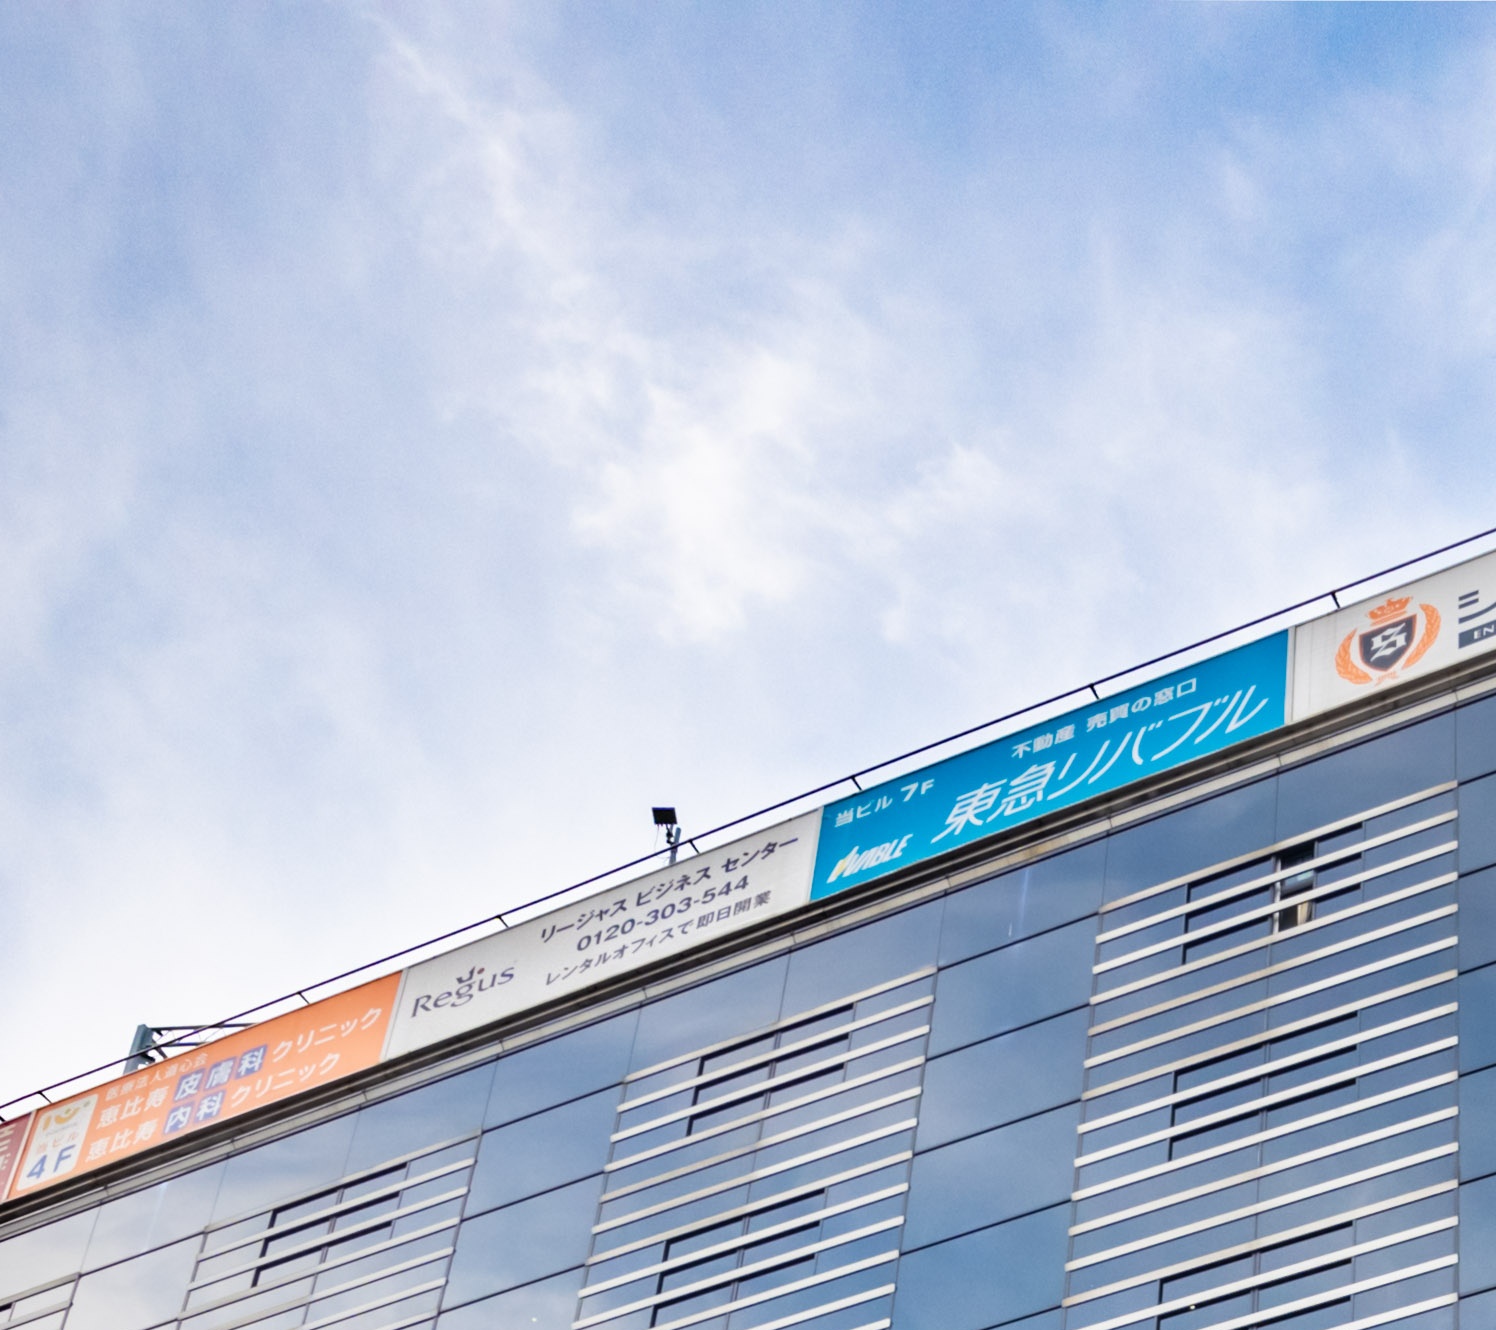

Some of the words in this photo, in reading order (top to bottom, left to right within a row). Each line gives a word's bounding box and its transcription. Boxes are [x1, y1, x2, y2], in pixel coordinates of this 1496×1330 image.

[1012, 724, 1076, 760] 不動産
[1086, 677, 1197, 732] 売買の窓口
[834, 795, 893, 828] 当ビル
[900, 778, 935, 803] 7F
[931, 684, 1269, 844] 東急リバブル
[541, 900, 627, 943] リージャス
[636, 867, 711, 907] ビジネス
[721, 836, 799, 872] センター
[577, 874, 749, 952] 0120-303-544
[411, 966, 515, 1018] Regus
[27, 1144, 75, 1181] 4F
